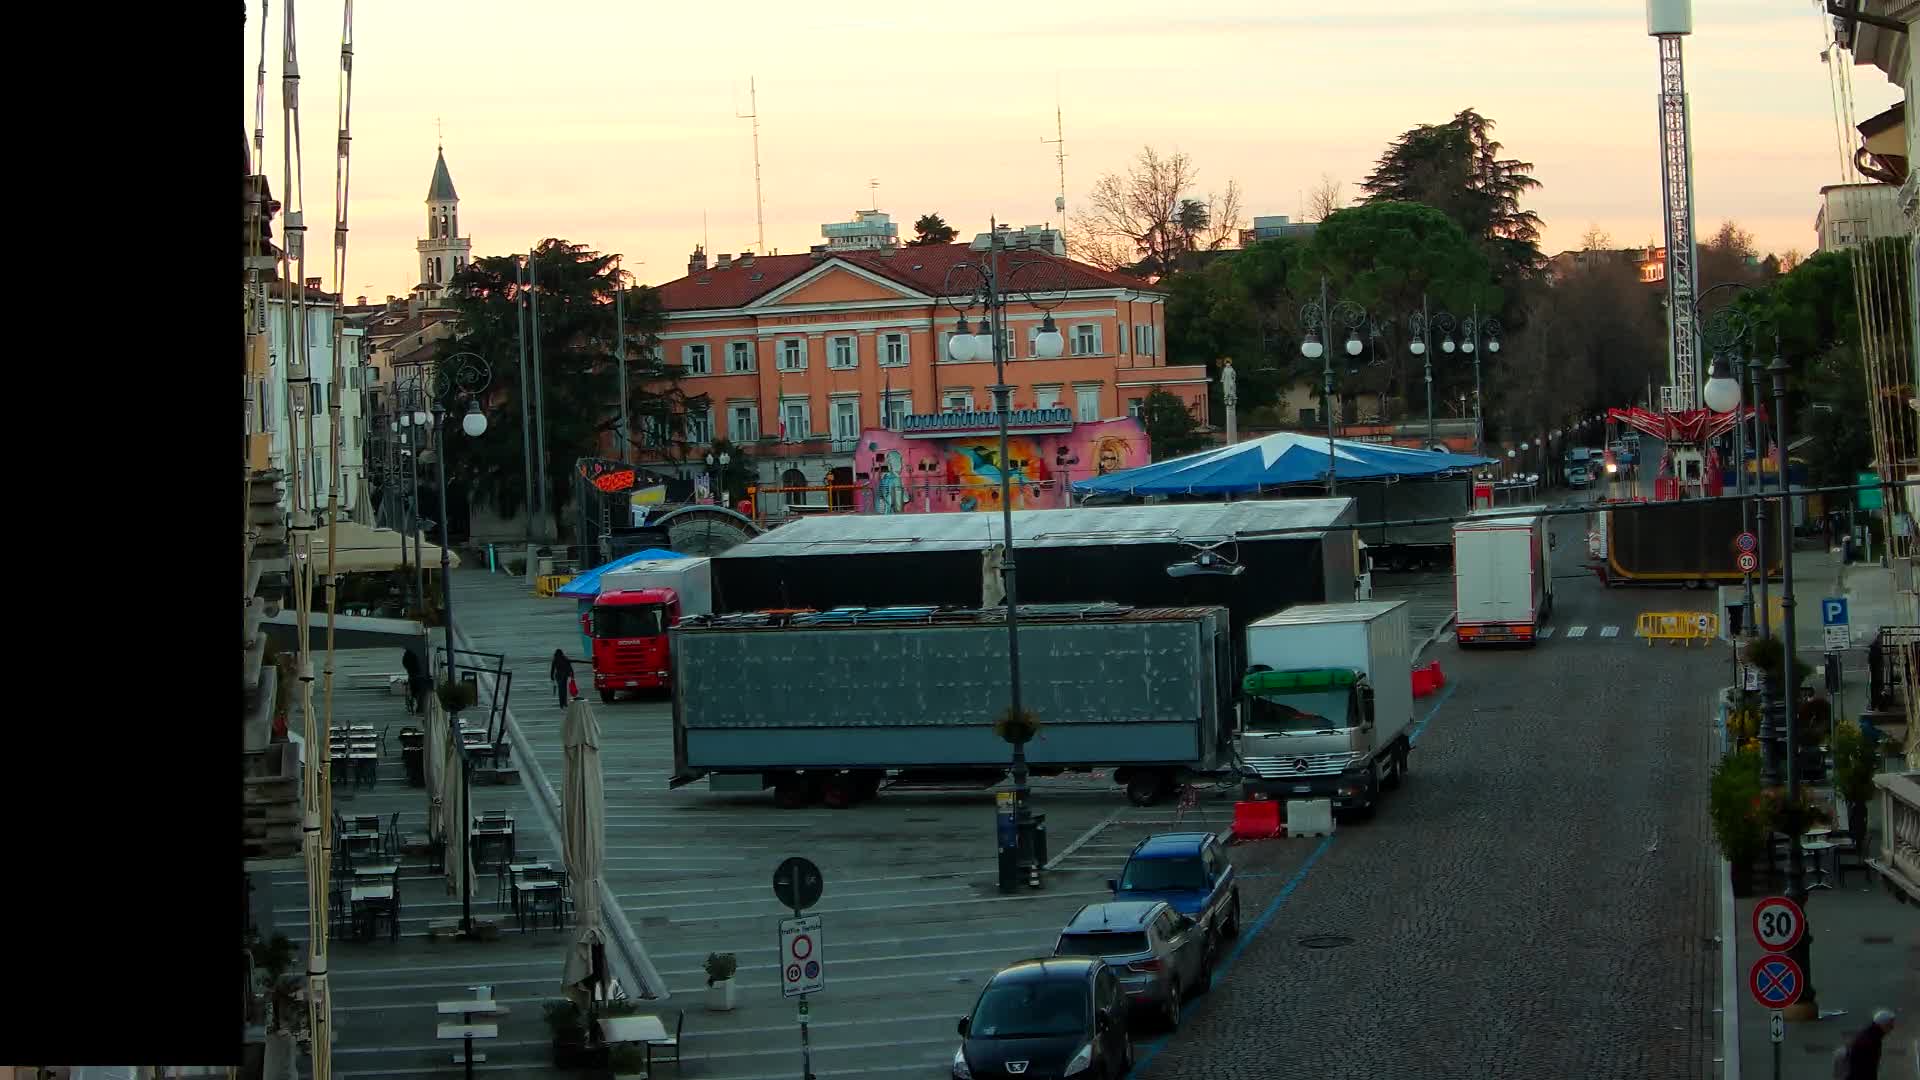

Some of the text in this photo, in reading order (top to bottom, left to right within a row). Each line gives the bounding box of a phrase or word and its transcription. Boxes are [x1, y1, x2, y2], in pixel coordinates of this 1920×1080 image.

[1742, 557, 1752, 567] 20
[1827, 602, 1842, 622] P
[1761, 911, 1793, 938] 30
